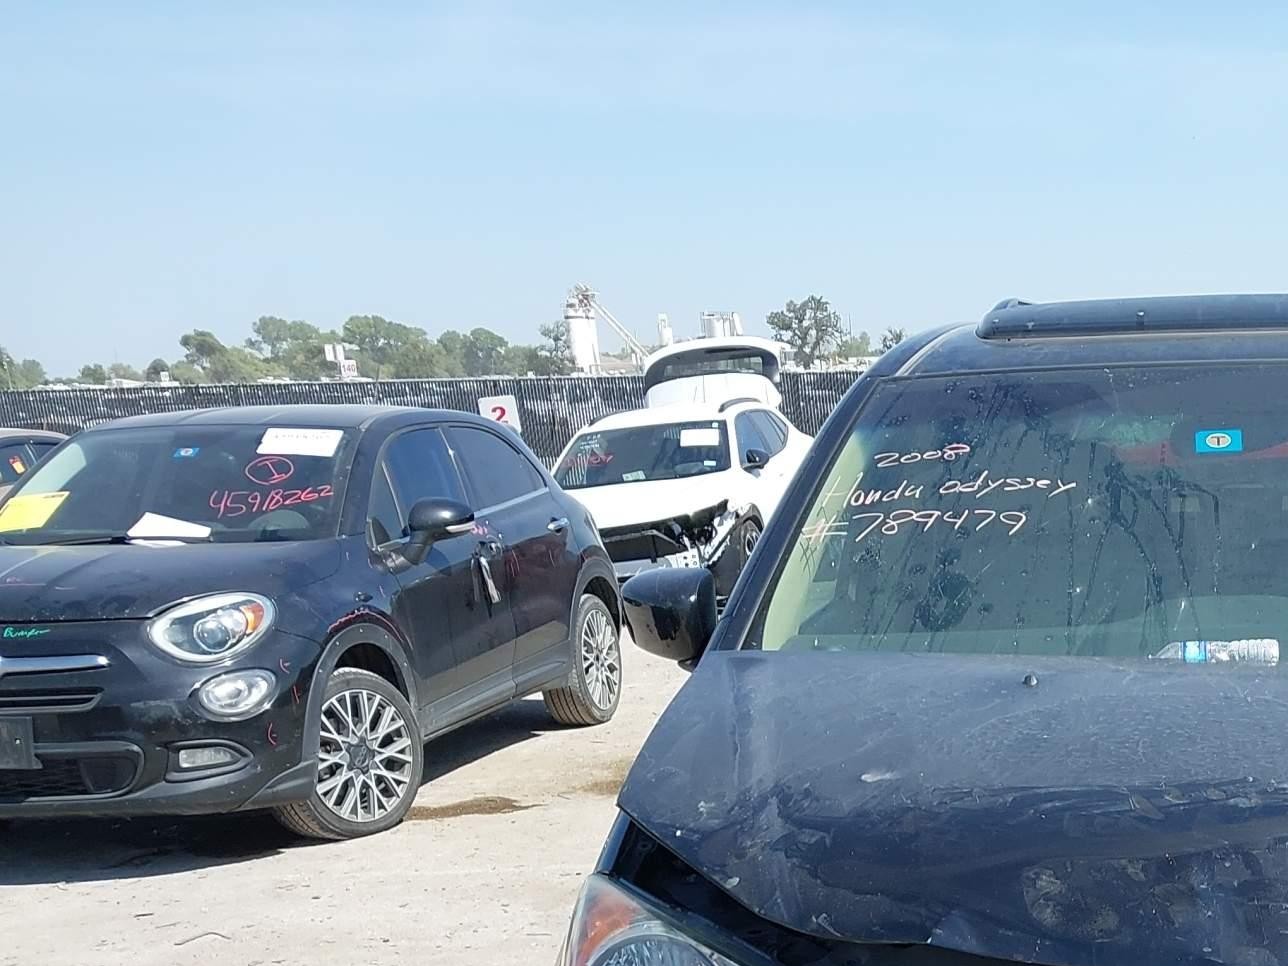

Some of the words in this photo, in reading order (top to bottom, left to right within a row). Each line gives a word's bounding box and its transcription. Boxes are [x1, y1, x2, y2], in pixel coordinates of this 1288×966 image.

[491, 406, 506, 422] 2
[874, 443, 971, 468] 2008
[209, 485, 334, 519] 45918262
